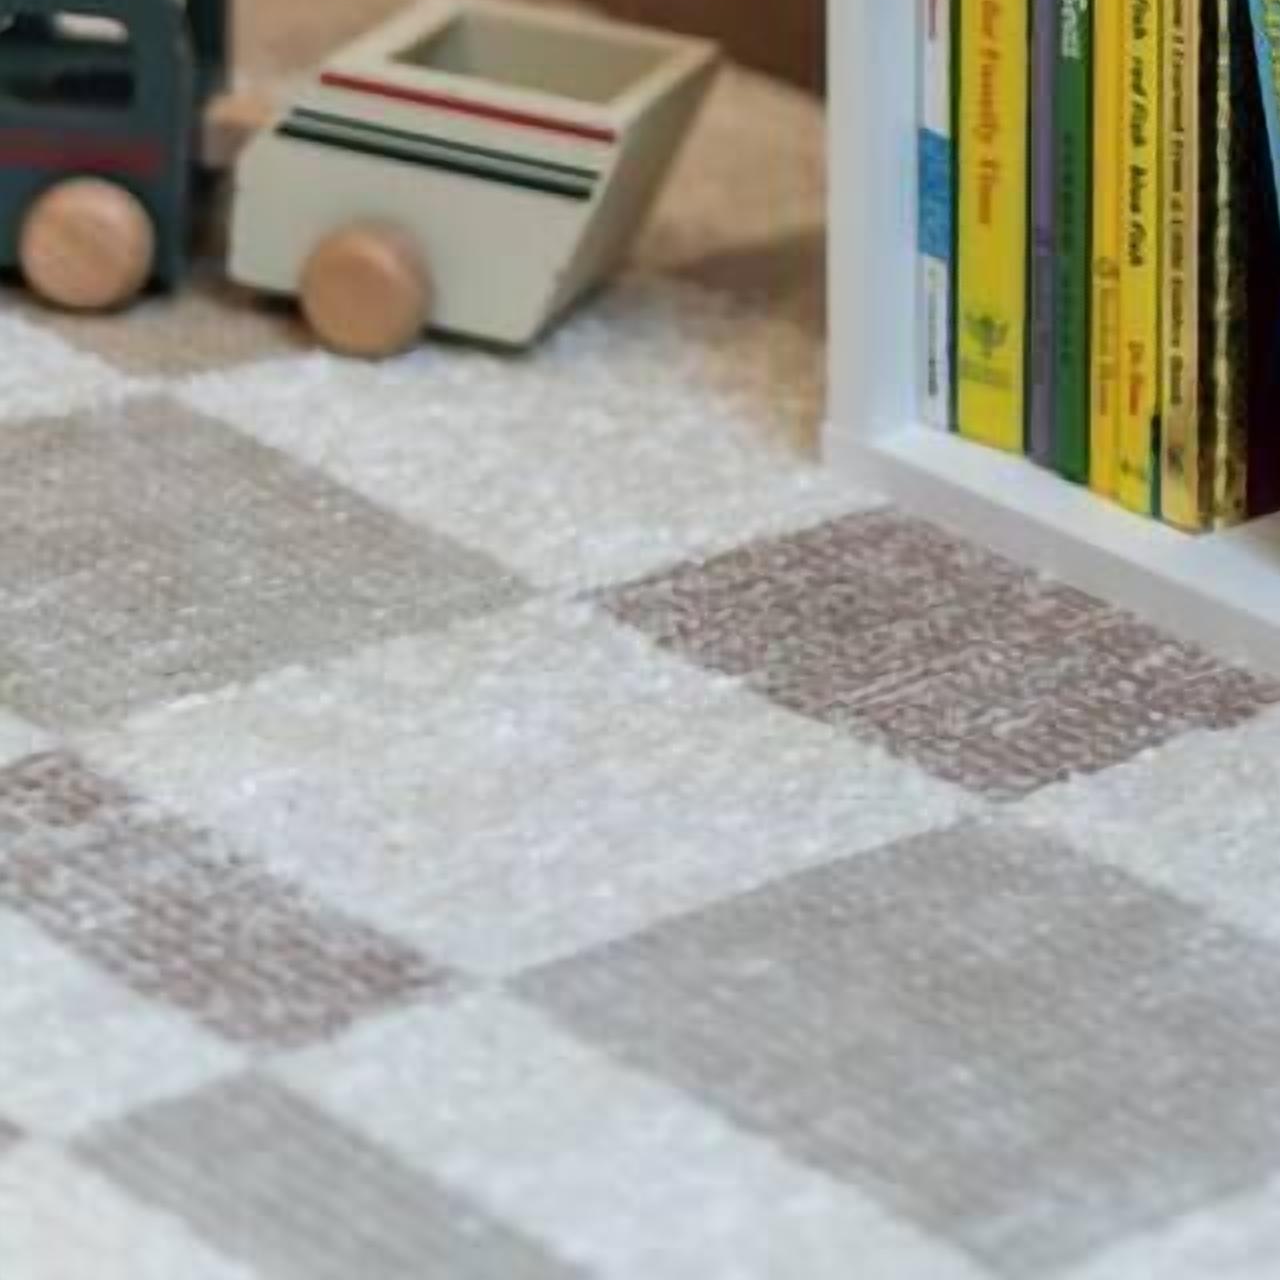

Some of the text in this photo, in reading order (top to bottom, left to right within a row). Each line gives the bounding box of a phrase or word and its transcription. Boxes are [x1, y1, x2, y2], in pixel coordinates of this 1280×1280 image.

[1130, 55, 1149, 99] red
[1130, 100, 1151, 148] fish
[1129, 164, 1150, 214] blue
[1128, 219, 1148, 268] fish
